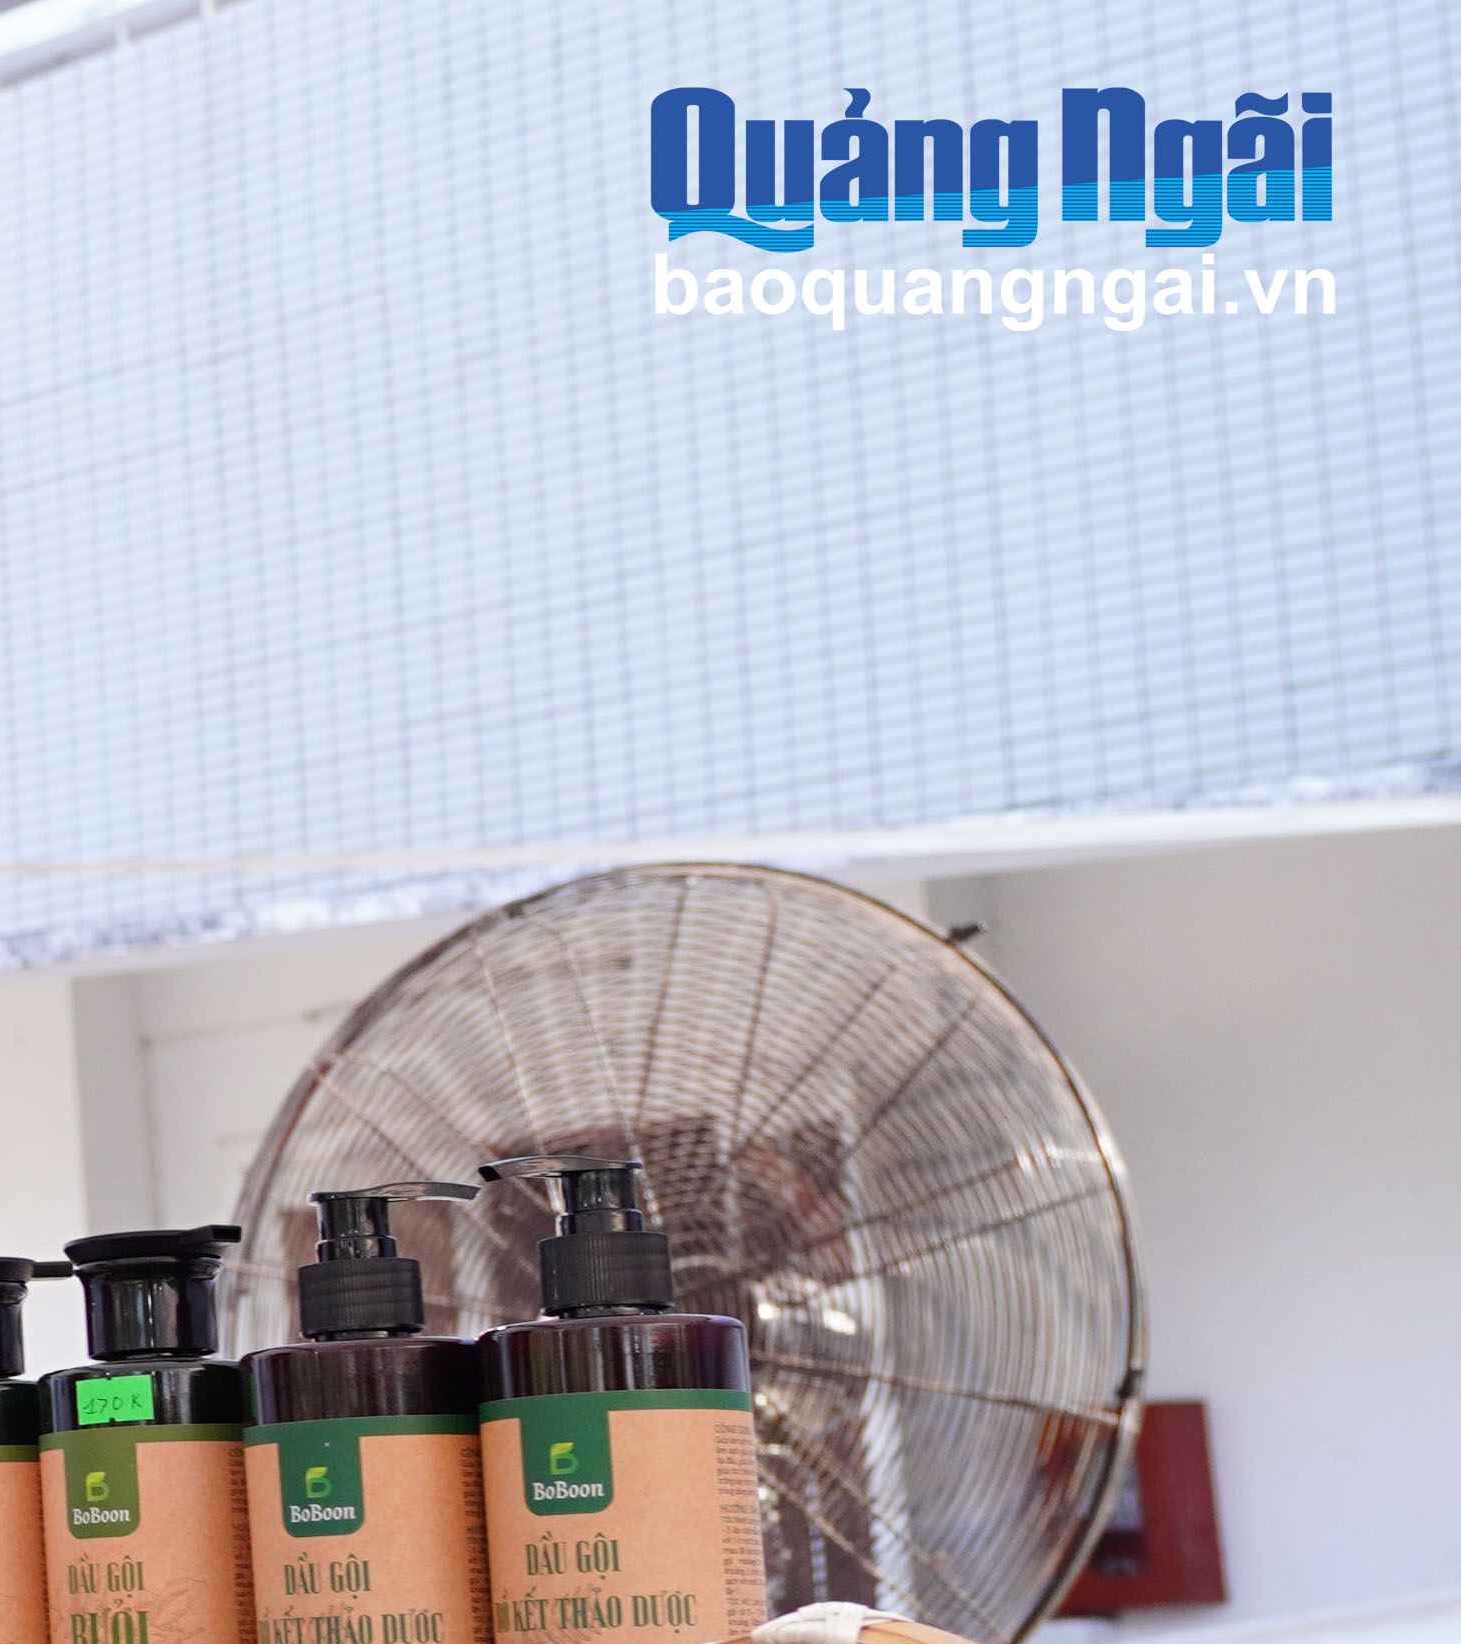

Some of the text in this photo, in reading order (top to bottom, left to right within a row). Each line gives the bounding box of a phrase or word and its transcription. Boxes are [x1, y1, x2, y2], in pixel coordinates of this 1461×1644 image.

[289, 1504, 356, 1523] BoBoon
[531, 1480, 605, 1501] BoBoon
[73, 1507, 131, 1525] BoBoon
[68, 1552, 145, 1598] DẦU GỘI
[284, 1551, 372, 1599] DẦU GỘI
[525, 1531, 621, 1580] DẦU GỘI
[513, 1586, 548, 1632] KẾT
[555, 1587, 623, 1630] THẢO
[631, 1590, 697, 1634] DƯỢC
